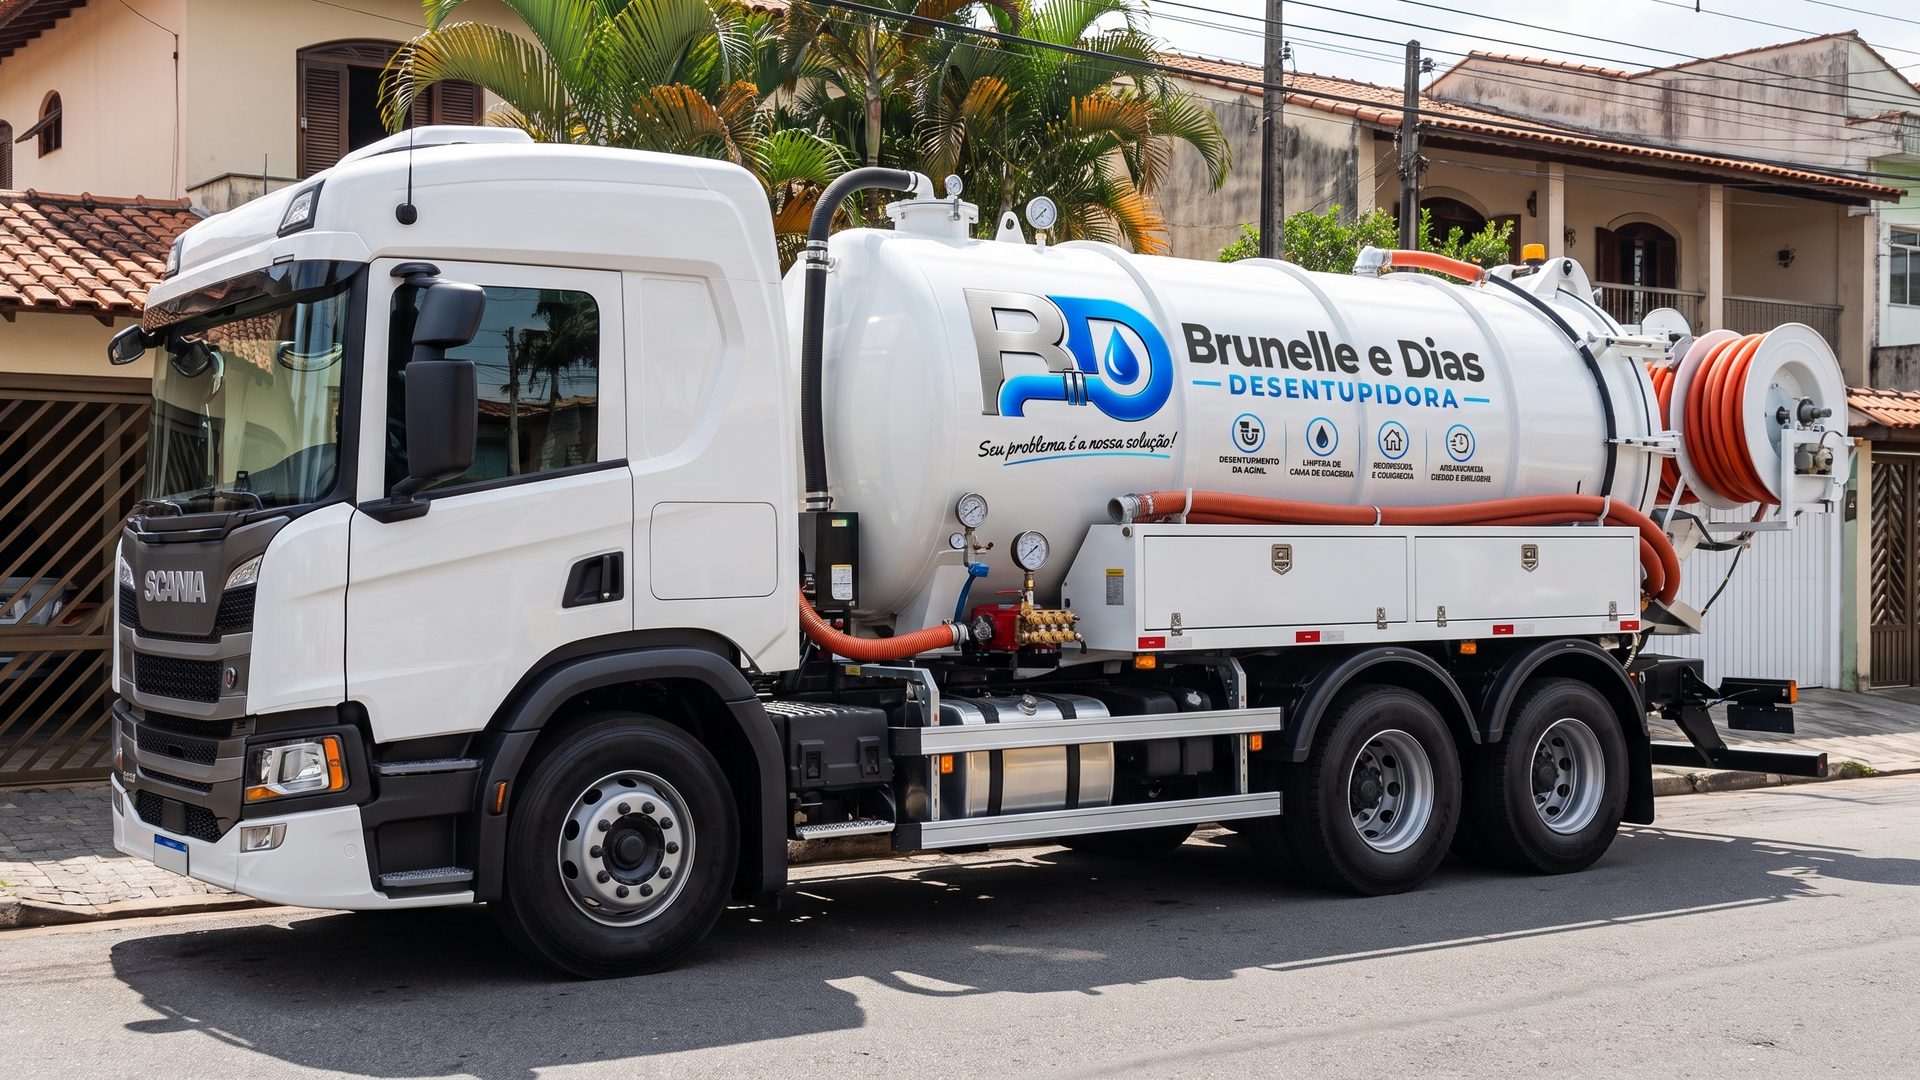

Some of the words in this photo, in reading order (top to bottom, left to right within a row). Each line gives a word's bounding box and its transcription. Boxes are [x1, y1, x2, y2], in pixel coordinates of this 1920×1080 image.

[1181, 322, 1360, 375] Brunelle
[1368, 345, 1393, 376] e
[1397, 336, 1485, 382] Dias
[1229, 374, 1459, 409] DESENTUPIDORA
[978, 440, 1005, 458] Seu
[1005, 435, 1067, 461] problema
[1069, 435, 1078, 450] é
[1078, 441, 1087, 450] a
[1089, 438, 1124, 450] nossa
[1126, 431, 1178, 453] solução!
[1332, 460, 1342, 468] DE
[1232, 466, 1242, 474] DA
[1311, 469, 1320, 477] DE
[1371, 471, 1377, 479] E
[1455, 474, 1460, 482] E
[144, 570, 206, 603] SCANIA
